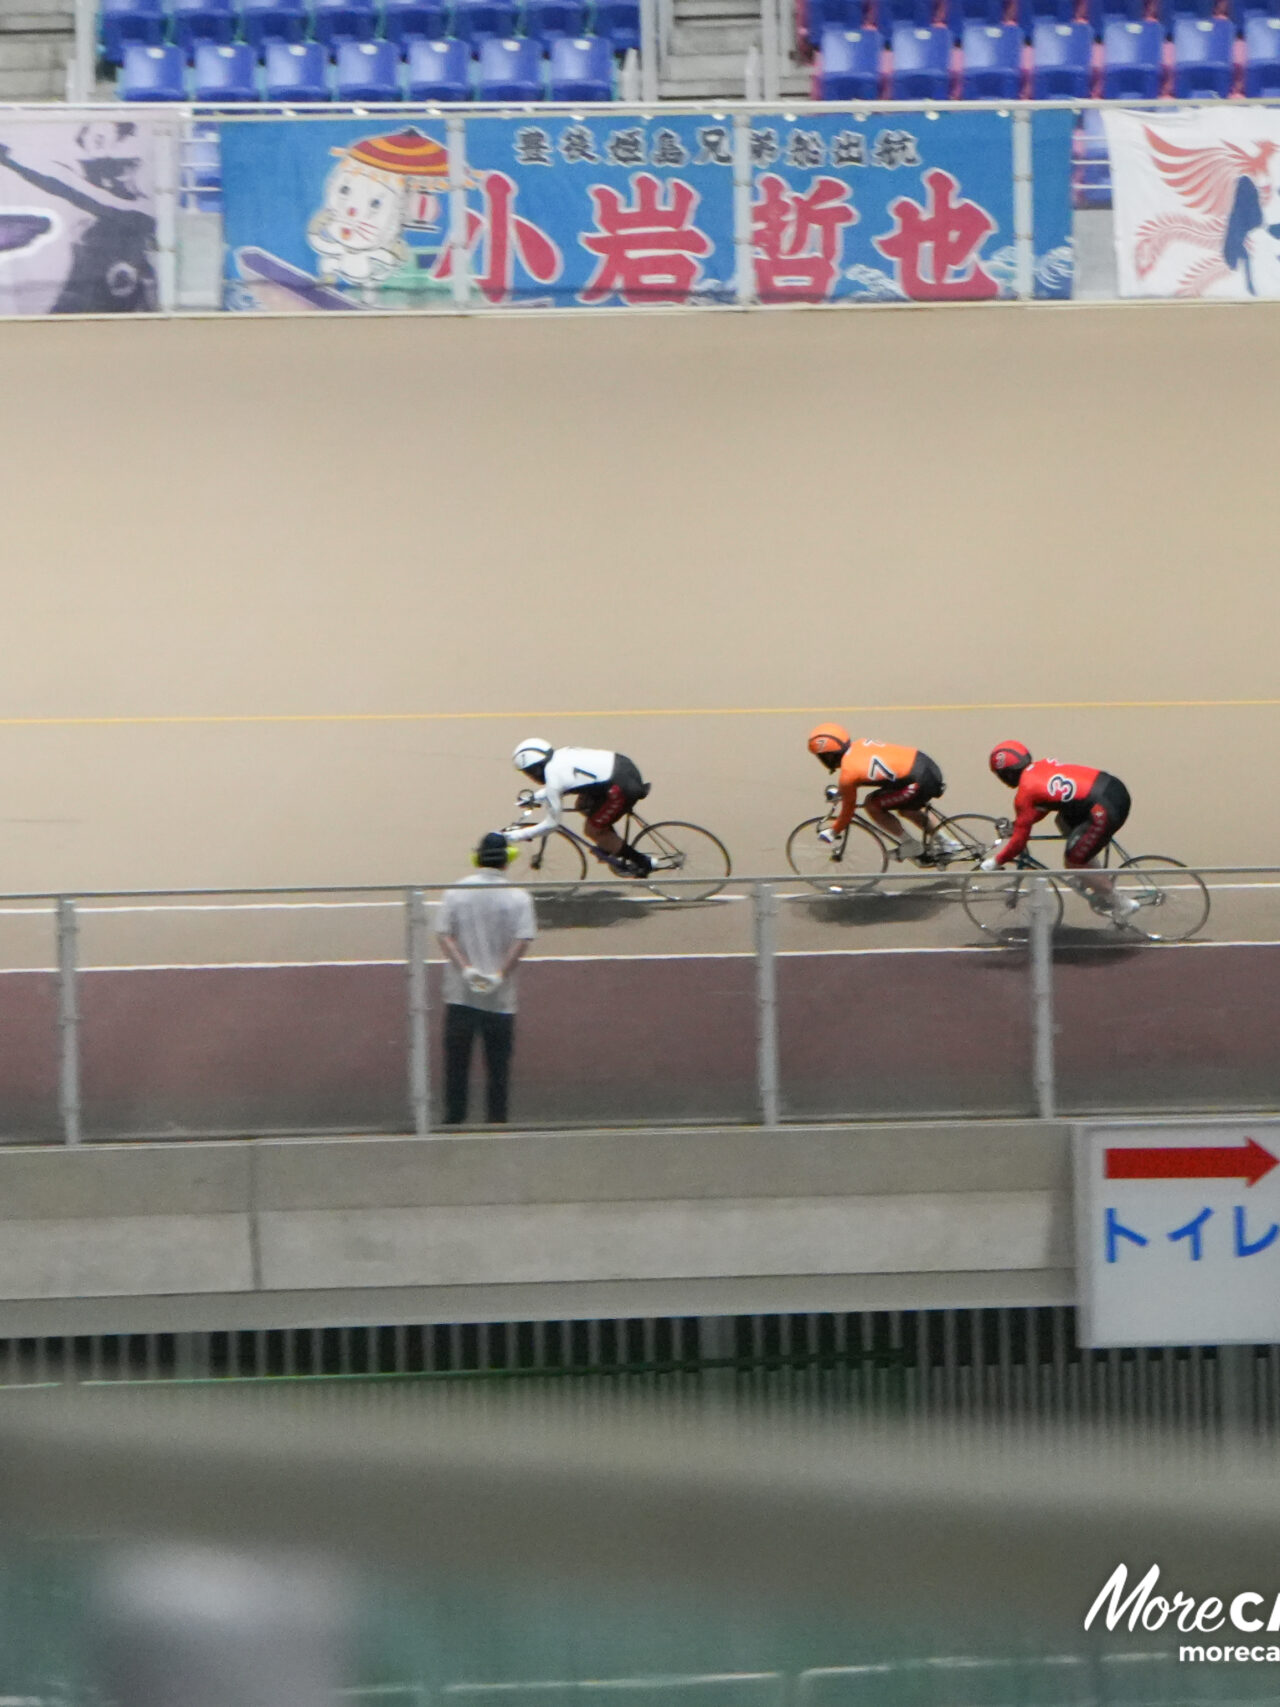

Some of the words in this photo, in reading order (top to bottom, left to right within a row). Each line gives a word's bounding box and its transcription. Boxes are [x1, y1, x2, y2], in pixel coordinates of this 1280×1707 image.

[429, 168, 1000, 304] 小岩哲也
[572, 766, 598, 781] 1
[868, 755, 897, 782] 7
[1047, 773, 1078, 803] 3
